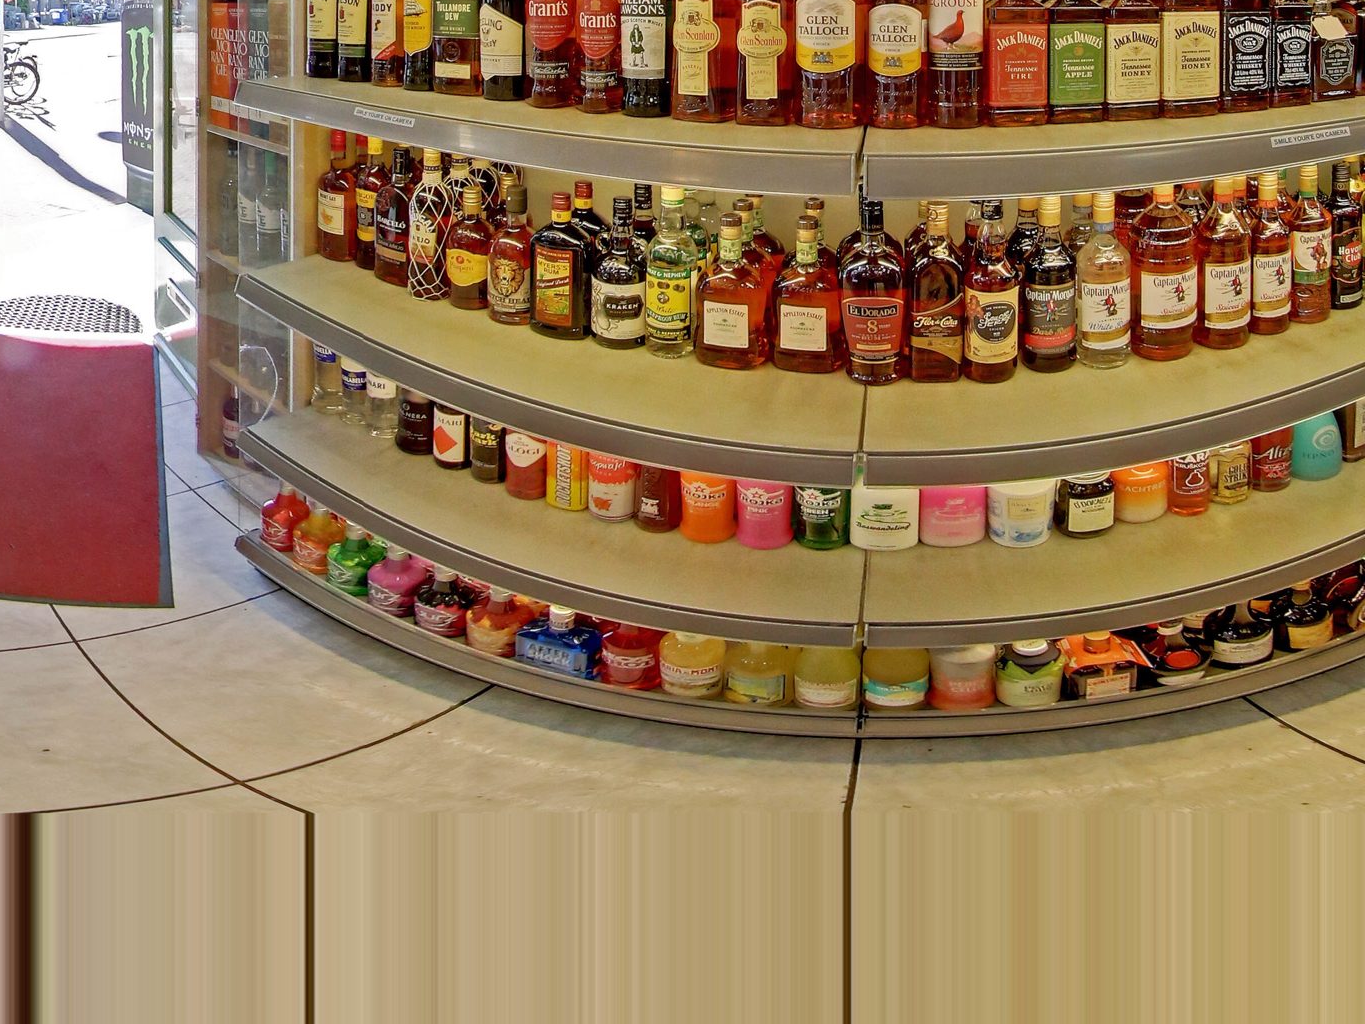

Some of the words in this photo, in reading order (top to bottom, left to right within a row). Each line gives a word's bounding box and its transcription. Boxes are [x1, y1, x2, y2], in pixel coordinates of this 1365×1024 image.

[436, 2, 471, 13] TULLAMORE
[529, 0, 568, 18] Grant's
[445, 11, 459, 21] DEW
[579, 12, 616, 28] Grant's
[806, 16, 838, 25] GLEN
[686, 28, 715, 41] Scanlan
[799, 26, 849, 36] TALLOCH
[879, 25, 908, 33] GLEN
[1175, 24, 1191, 40] JACK
[1192, 21, 1217, 38] DANIEL'S
[1228, 24, 1245, 39] JACK
[1245, 21, 1269, 38] DANIEL'S
[740, 36, 754, 46] Glen
[755, 36, 783, 47] Scanlan
[872, 34, 917, 43] TALLOCH
[996, 33, 1016, 50] JACK
[1017, 31, 1046, 50] DANIEL'S
[1054, 33, 1073, 50] JACK
[1073, 31, 1103, 50] DANIEL'S
[1114, 33, 1131, 50] JACK
[1132, 31, 1158, 49] DANIEL'S
[1276, 30, 1291, 43] JACK
[1004, 65, 1038, 73] Tennessee
[1274, 137, 1292, 145] SMILE
[1325, 129, 1349, 138] CAMERA
[538, 259, 568, 271] MYERS'S
[1255, 257, 1280, 269] Captain
[1210, 269, 1237, 280] Captain
[1154, 276, 1180, 288] Captain
[1026, 288, 1051, 302] Captain
[1083, 284, 1110, 297] Captain
[606, 303, 638, 311] KRAKEN
[849, 306, 859, 315] EL
[860, 307, 897, 317] DORADO
[868, 321, 878, 334] 8
[800, 508, 830, 516] GREEN
